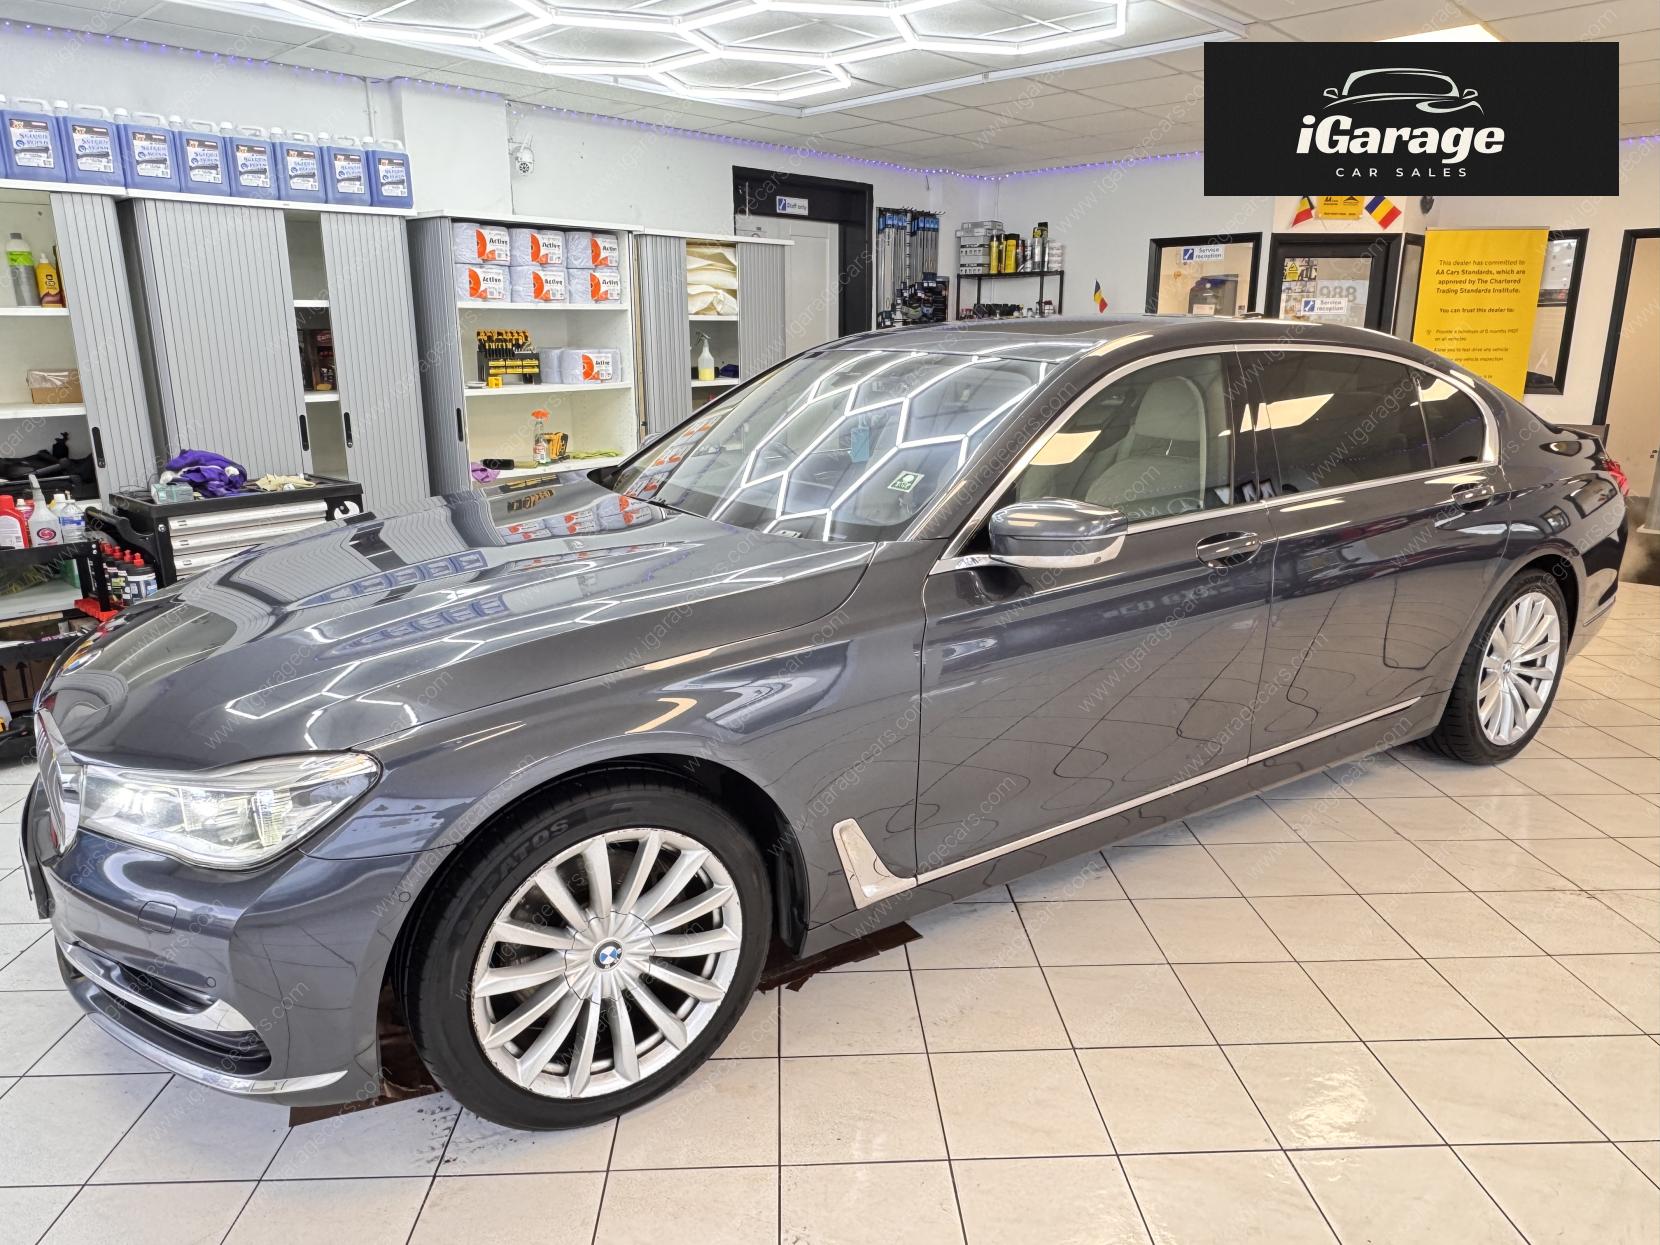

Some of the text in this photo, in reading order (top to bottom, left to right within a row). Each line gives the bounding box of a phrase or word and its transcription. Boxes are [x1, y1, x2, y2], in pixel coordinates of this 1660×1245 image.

[488, 237, 508, 246] Active
[541, 241, 561, 250] Active
[482, 276, 502, 284] Active
[544, 278, 563, 286] Active
